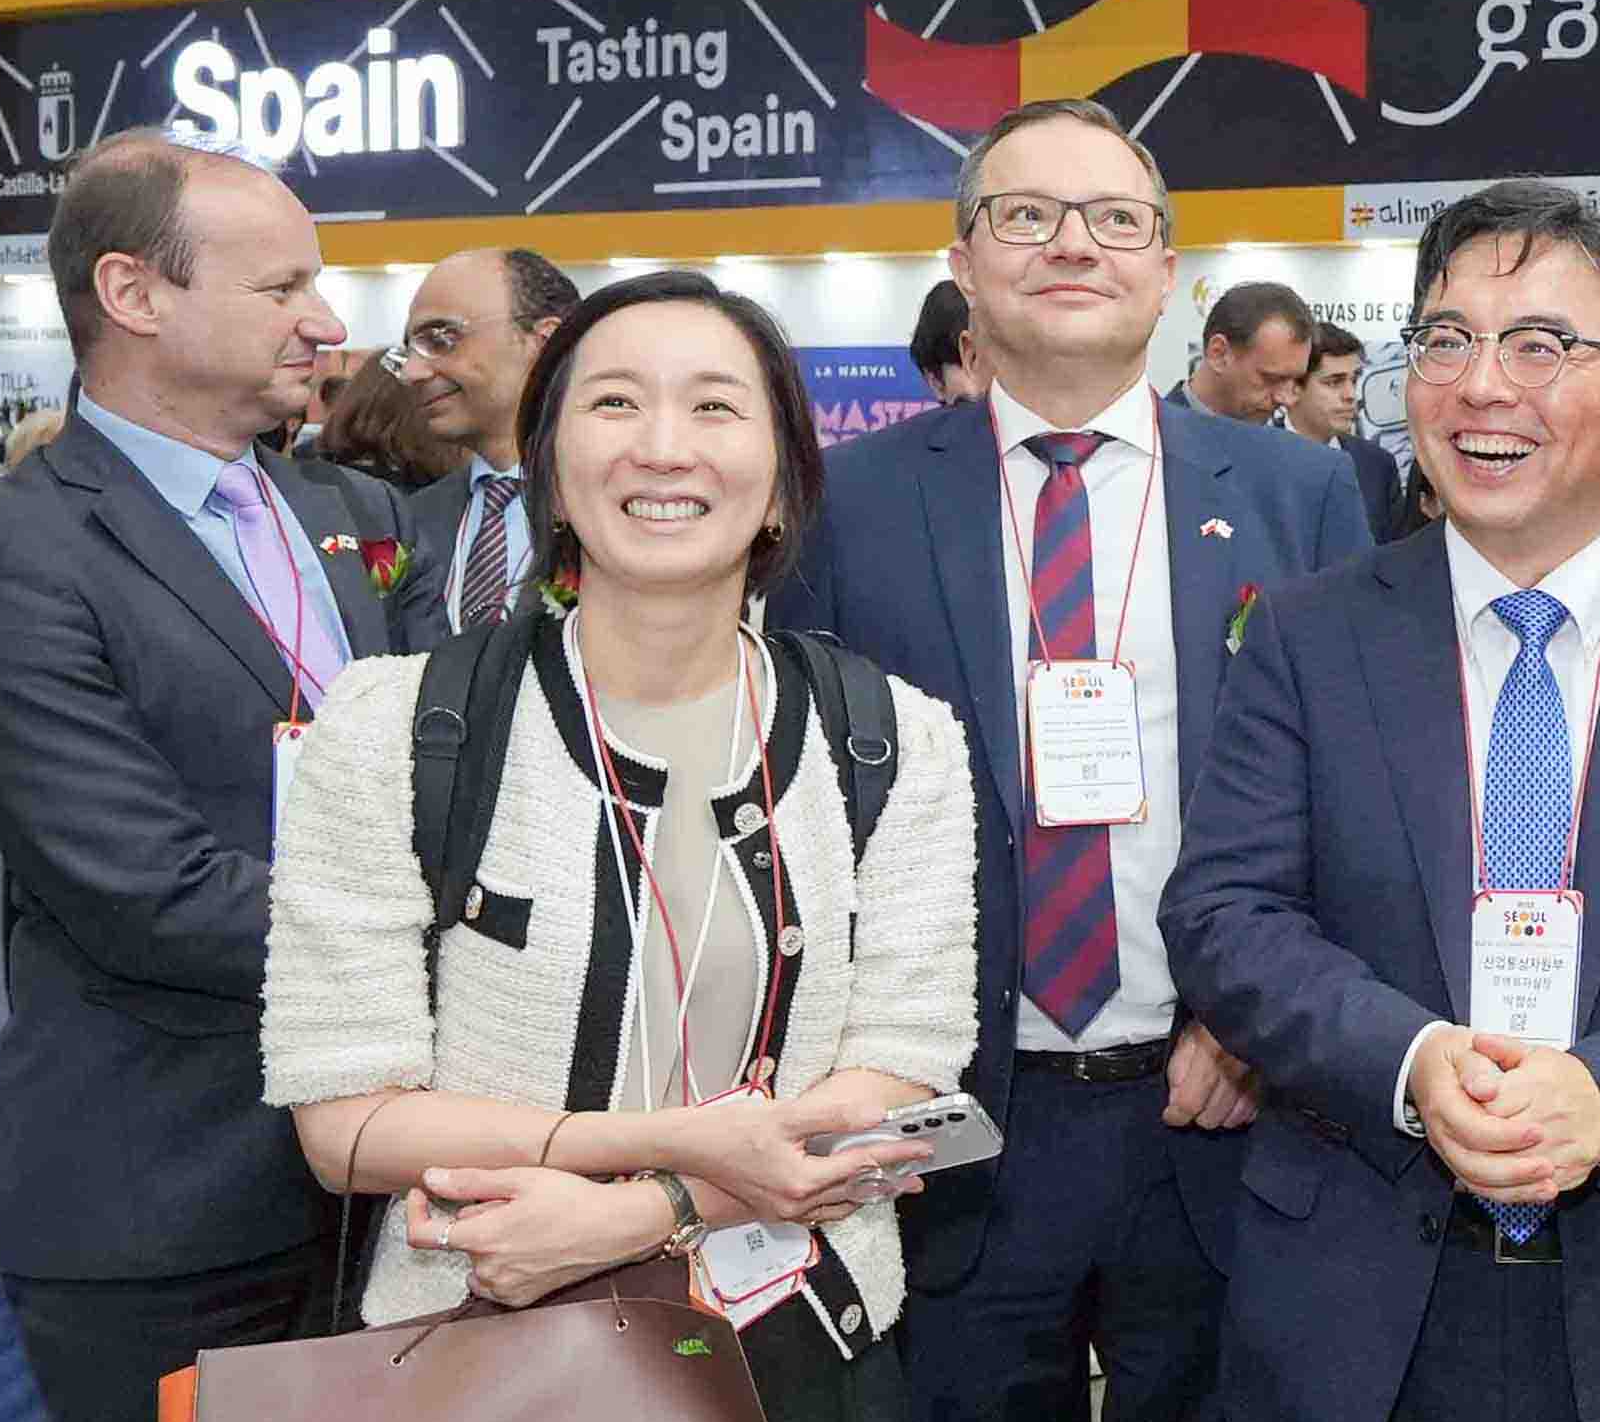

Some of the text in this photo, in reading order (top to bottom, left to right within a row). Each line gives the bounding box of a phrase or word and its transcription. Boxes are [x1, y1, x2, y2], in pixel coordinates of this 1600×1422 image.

[536, 17, 728, 90] Tasting
[171, 27, 468, 166] Spain
[660, 92, 816, 173] Spain
[1364, 303, 1385, 322] DE
[814, 365, 897, 378] LA NARVAL
[1503, 910, 1547, 923] SEOUL
